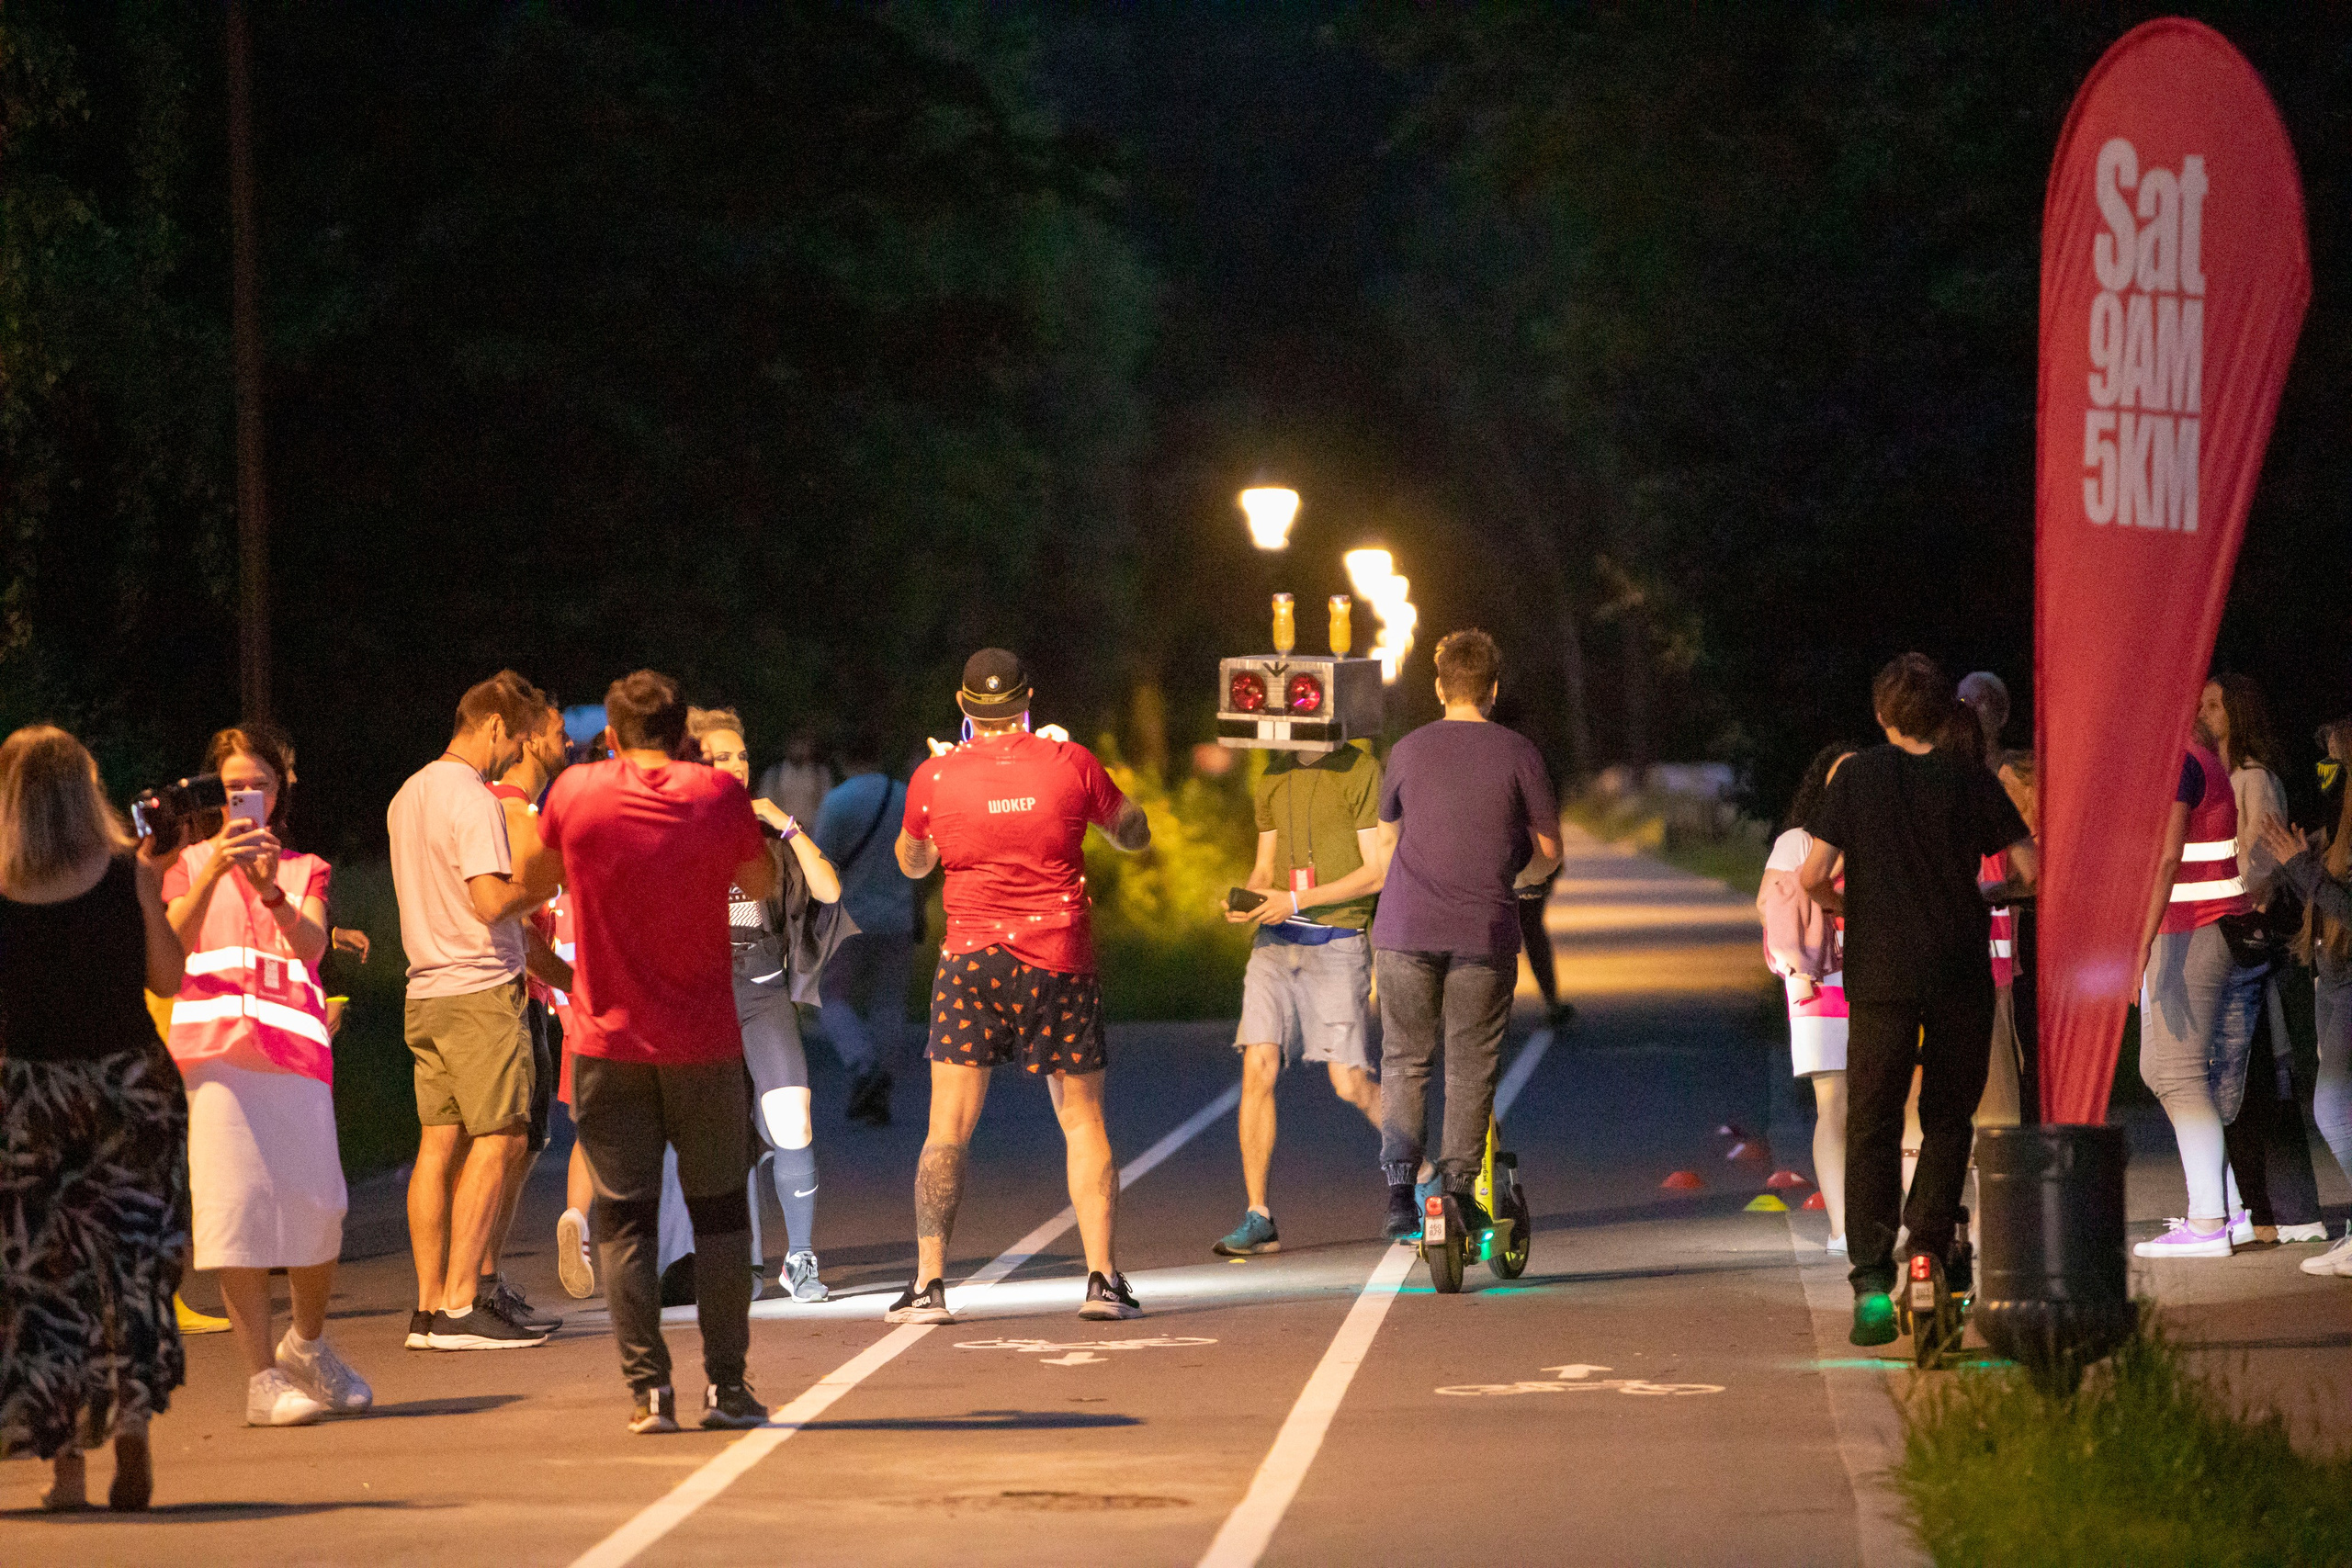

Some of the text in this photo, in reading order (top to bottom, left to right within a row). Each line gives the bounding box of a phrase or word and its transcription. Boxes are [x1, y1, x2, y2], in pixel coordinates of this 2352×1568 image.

[2094, 138, 2209, 296] Sat
[2088, 291, 2205, 412] 9AM
[2083, 409, 2202, 532] 5KM
[988, 796, 1036, 814] ШОКЕР
[911, 1295, 931, 1308] HOKA
